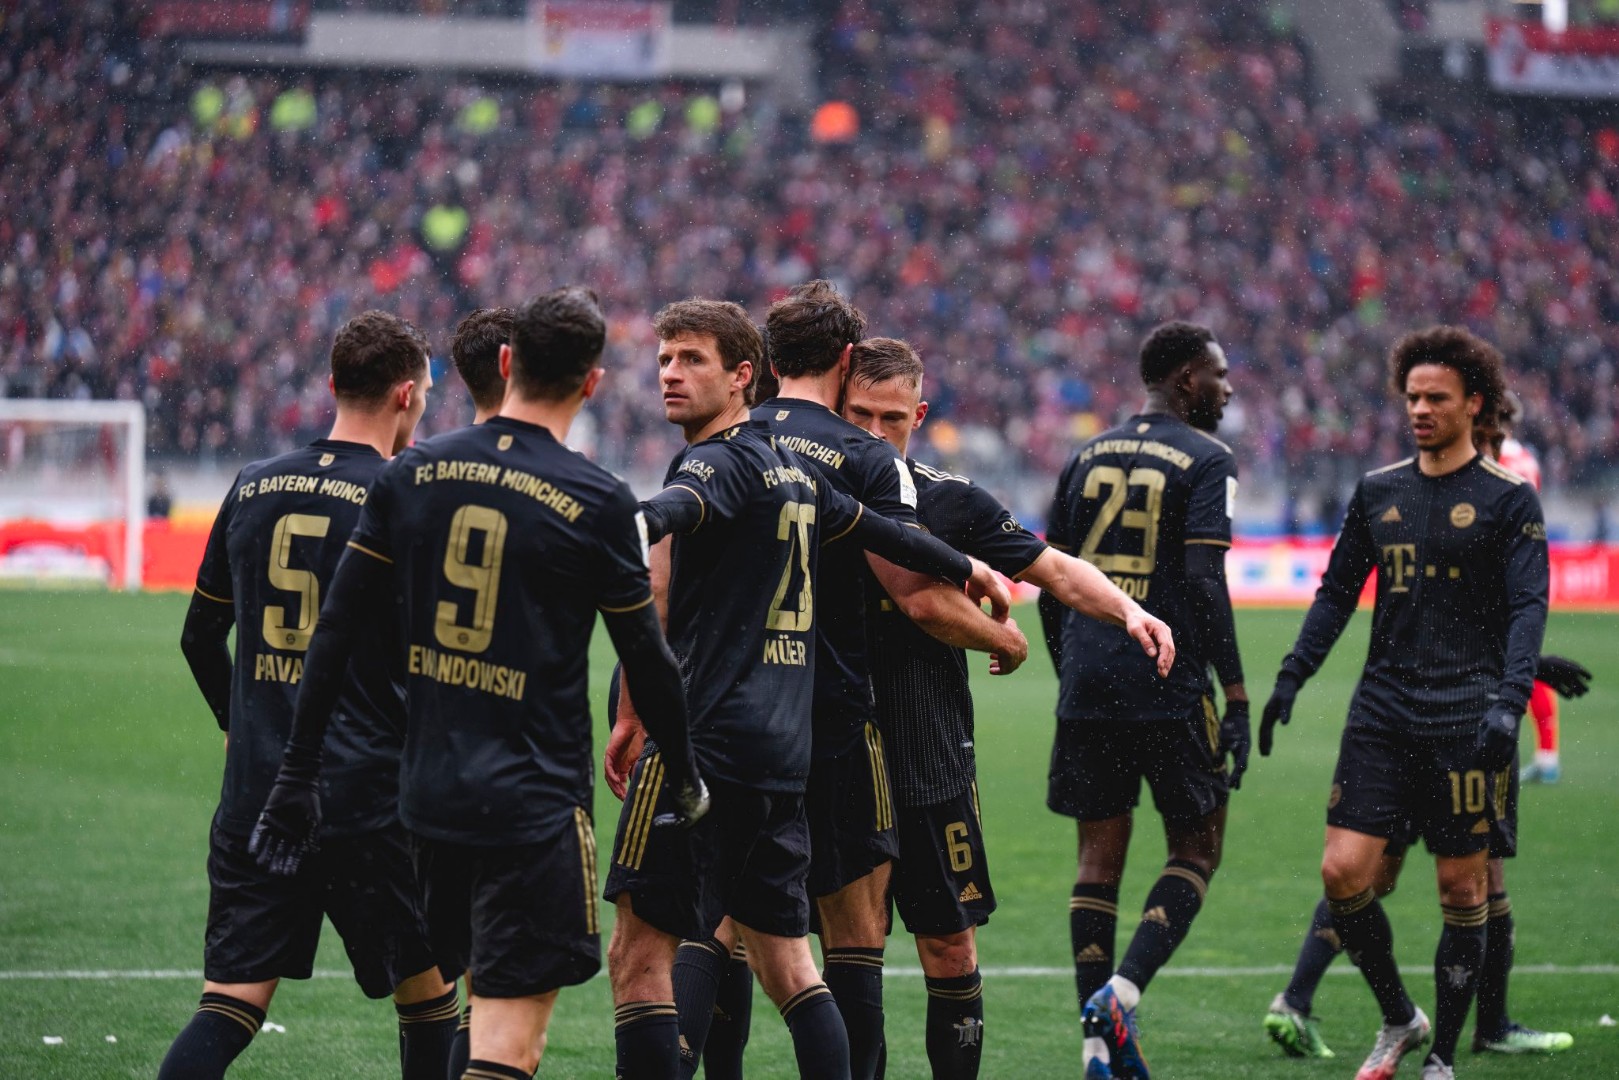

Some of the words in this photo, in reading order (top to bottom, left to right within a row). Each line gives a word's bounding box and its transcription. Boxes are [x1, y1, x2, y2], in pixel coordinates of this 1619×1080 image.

[239, 483, 255, 502] FC
[259, 475, 319, 494] BAYERN
[319, 478, 369, 506] MÜNC
[415, 465, 433, 485] FC
[437, 461, 500, 484] BAYERN
[501, 469, 584, 523] MÜNCHEN
[1080, 465, 1166, 575] 23
[262, 513, 331, 651] 5
[434, 504, 508, 653] 9
[255, 653, 305, 685] PAVA
[1448, 769, 1486, 816] 10
[945, 821, 972, 872] 6
[959, 892, 983, 903] adidas
